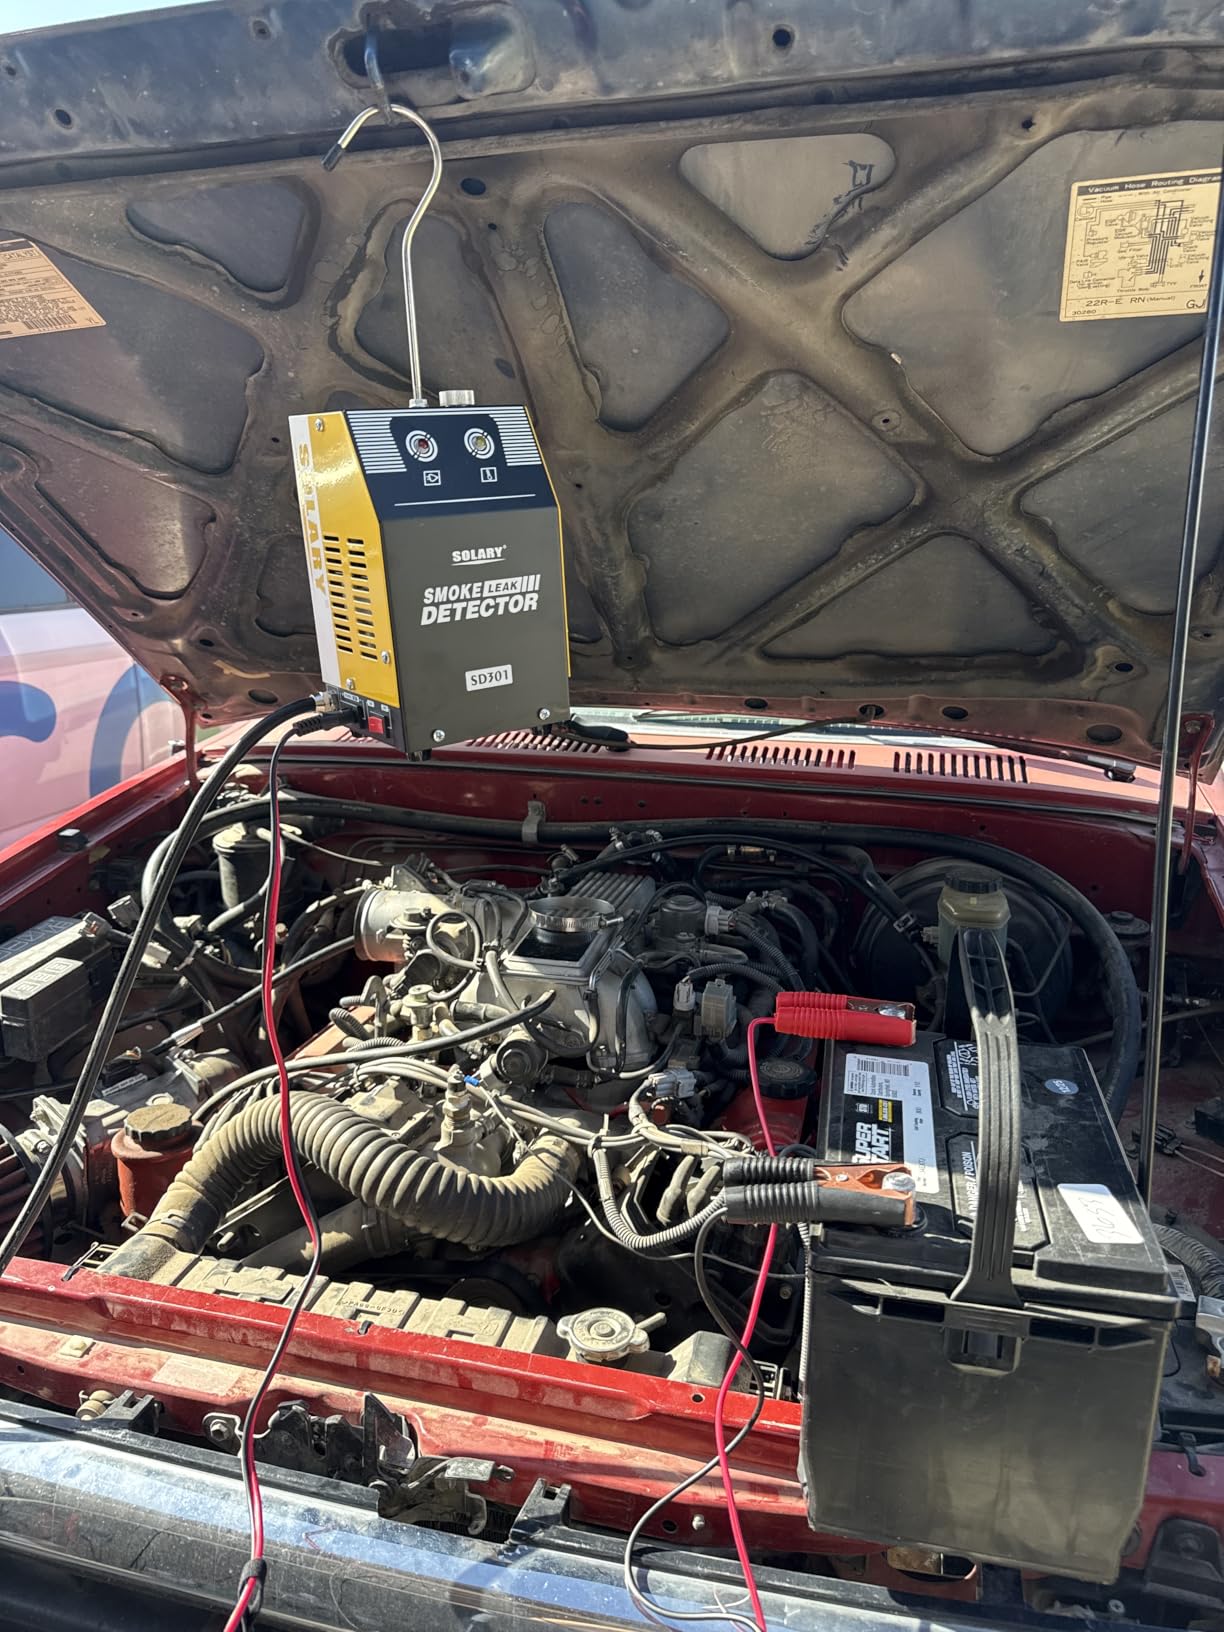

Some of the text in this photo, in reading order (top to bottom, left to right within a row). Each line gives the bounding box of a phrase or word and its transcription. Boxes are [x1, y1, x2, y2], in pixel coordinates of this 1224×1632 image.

[1088, 185, 1120, 193] Vacuum
[1124, 182, 1147, 190] Hose
[1151, 178, 1185, 188] Routing
[1085, 298, 1123, 307] 22R-E
[452, 546, 504, 562] SOLARY
[424, 580, 519, 604] SMOKE LEAK
[420, 592, 539, 625] DETECTOR
[470, 669, 509, 686] SD301
[870, 1123, 890, 1164] TART
